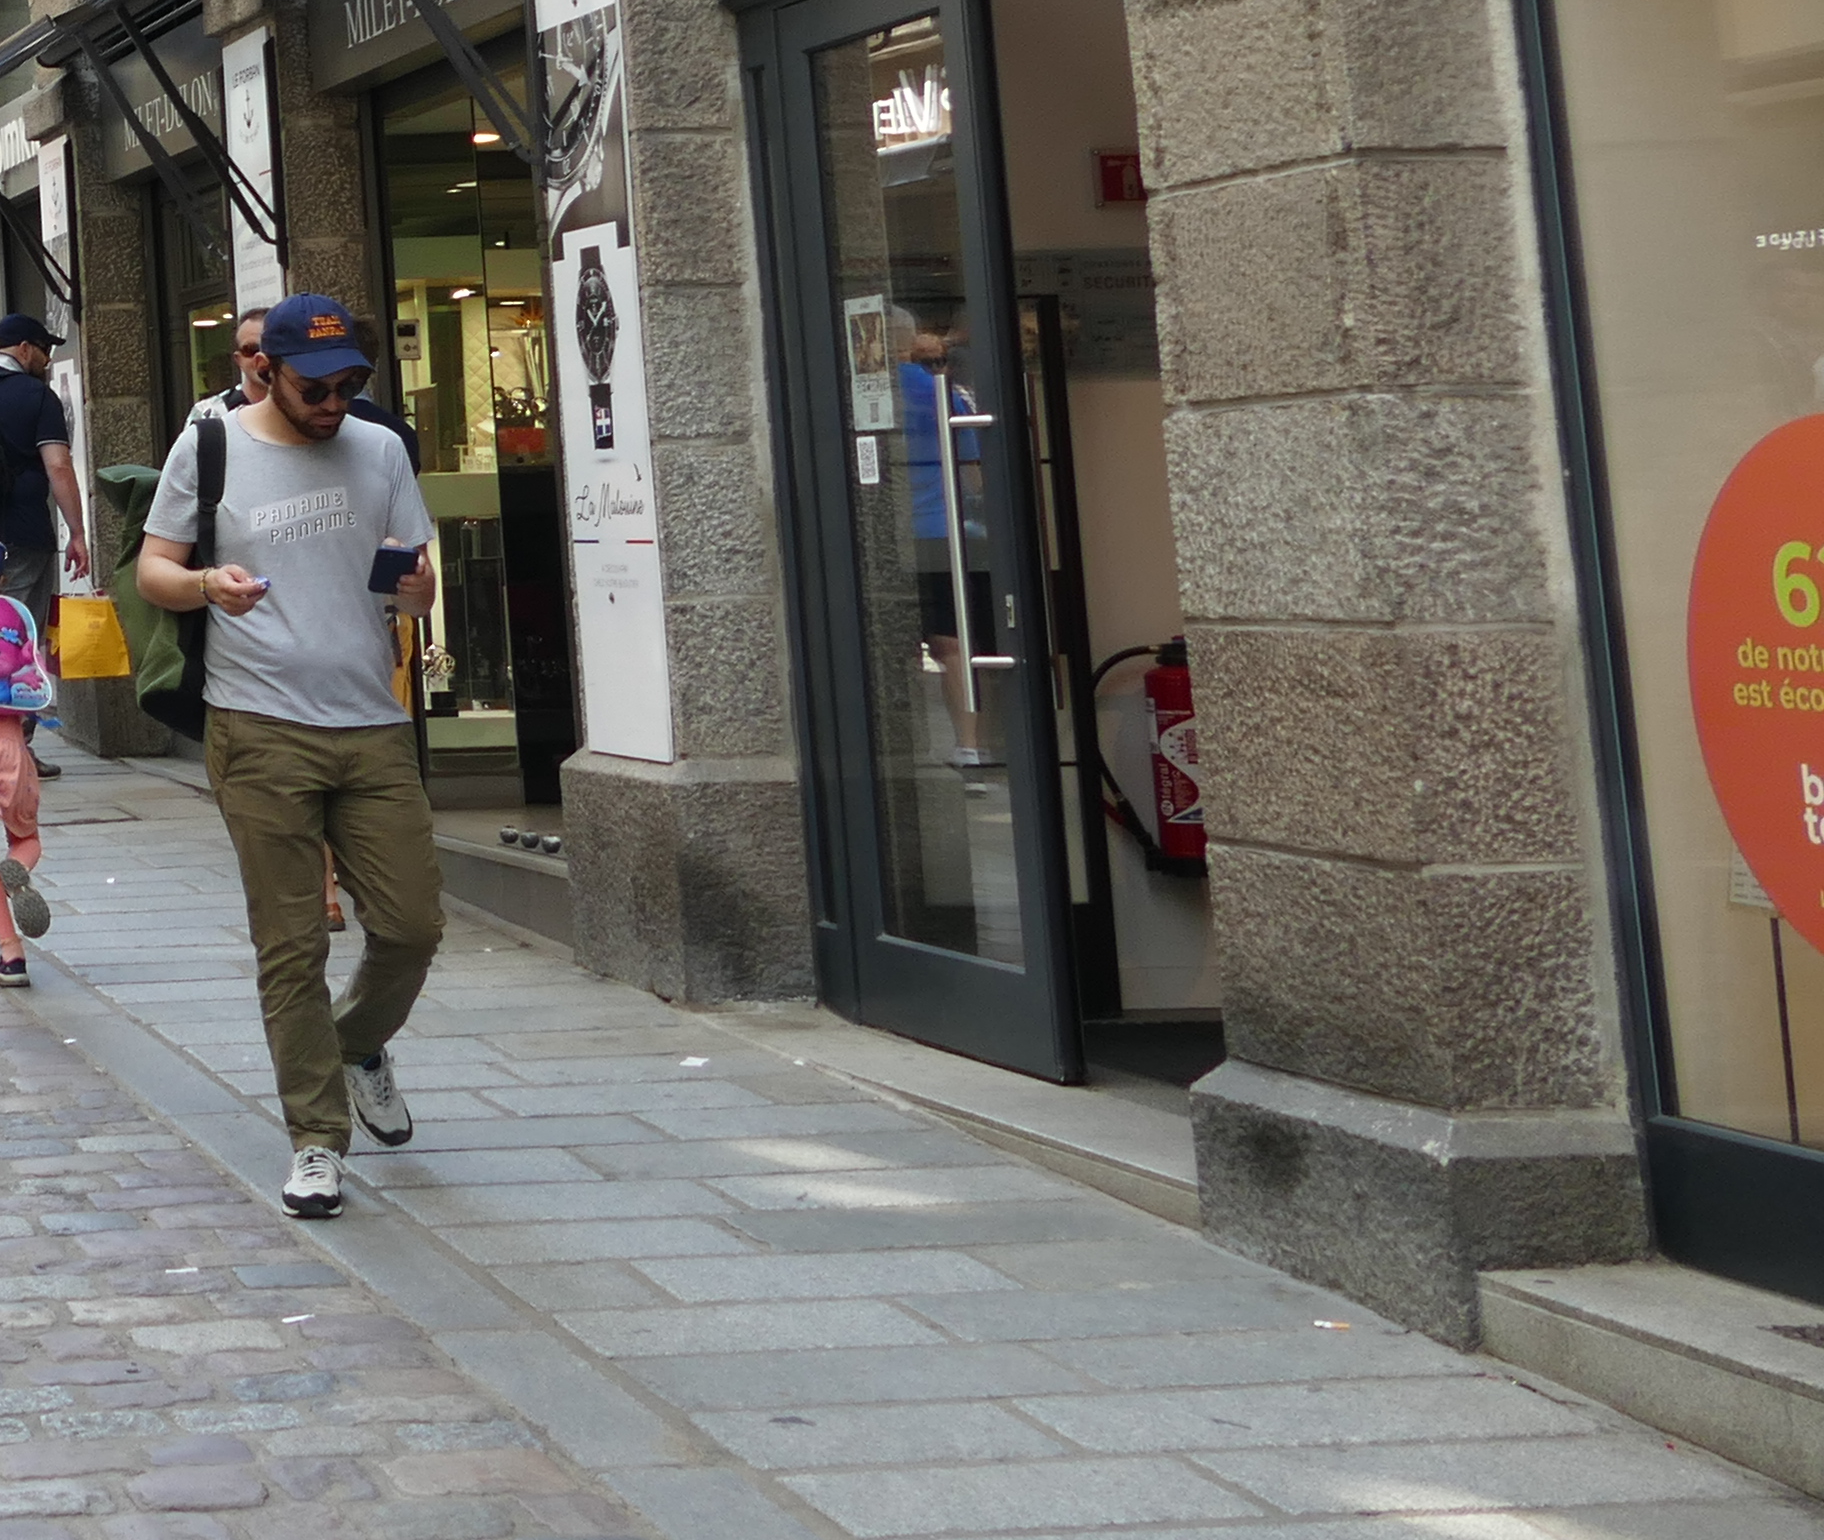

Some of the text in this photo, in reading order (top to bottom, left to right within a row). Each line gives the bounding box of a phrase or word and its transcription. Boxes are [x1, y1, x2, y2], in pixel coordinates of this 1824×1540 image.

[1083, 275, 1157, 290] SECURIT
[255, 491, 344, 526] PANAME
[270, 510, 357, 545] PANAME
[1771, 541, 1824, 628] 6
[1737, 638, 1769, 669] de
[1733, 679, 1773, 708] est
